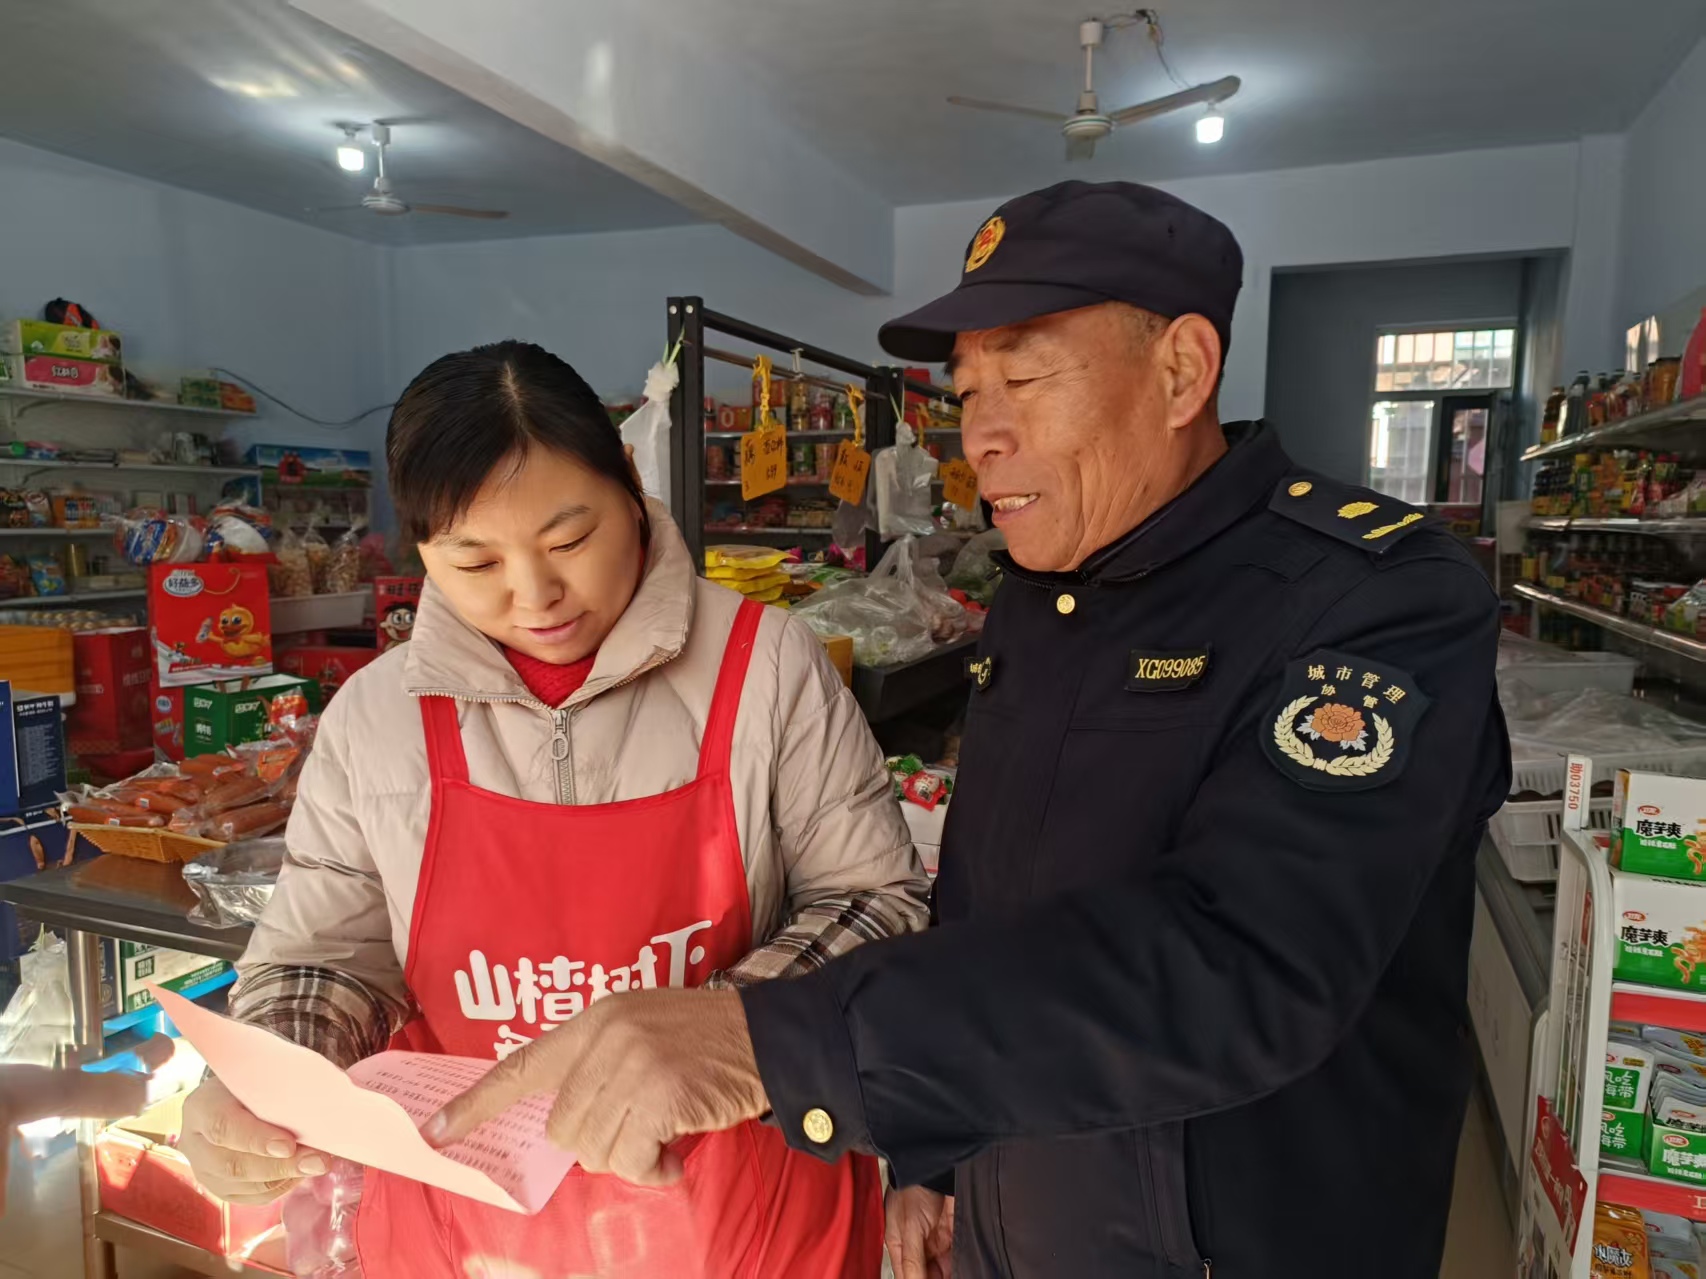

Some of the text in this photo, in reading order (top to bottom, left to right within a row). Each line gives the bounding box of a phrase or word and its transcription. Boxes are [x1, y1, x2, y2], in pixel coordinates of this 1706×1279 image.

[1135, 655, 1206, 680] XG099085
[1307, 664, 1406, 705] 城市管理
[1320, 683, 1380, 709] 协管
[1635, 819, 1682, 838] 魔芋爽
[1620, 925, 1669, 946] 魔芋爽
[454, 919, 712, 1024] 山楂树下
